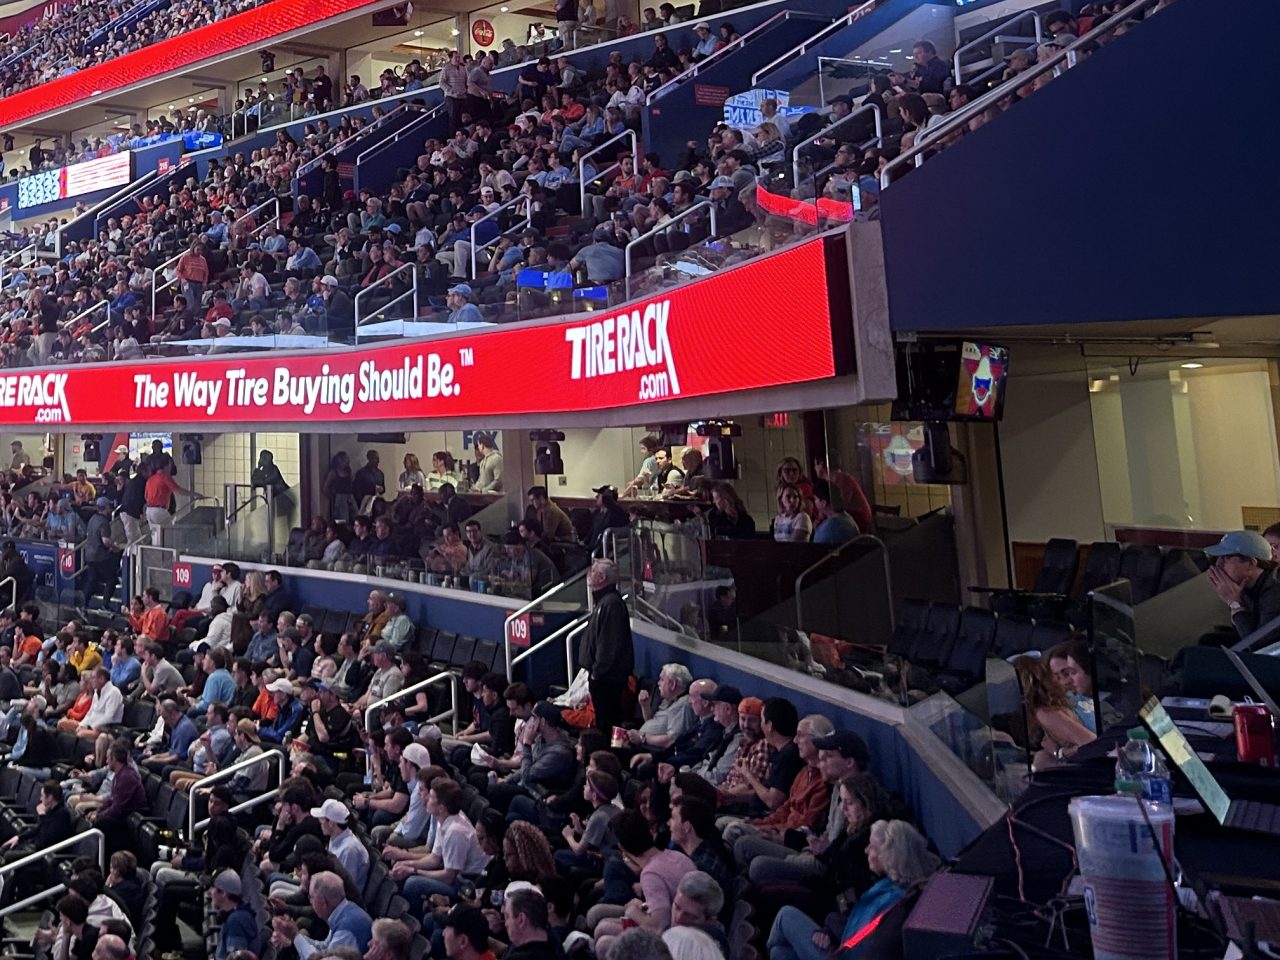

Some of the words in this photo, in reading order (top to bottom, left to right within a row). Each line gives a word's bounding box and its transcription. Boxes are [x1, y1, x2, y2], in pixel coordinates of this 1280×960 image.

[134, 373, 169, 408] The
[173, 371, 222, 416] Way
[226, 368, 269, 407] Tire
[273, 363, 355, 415] Buying
[358, 355, 423, 402] Should
[639, 371, 669, 400] .com
[35, 408, 62, 422] .com
[175, 568, 190, 583] 109
[511, 618, 527, 638] 109
